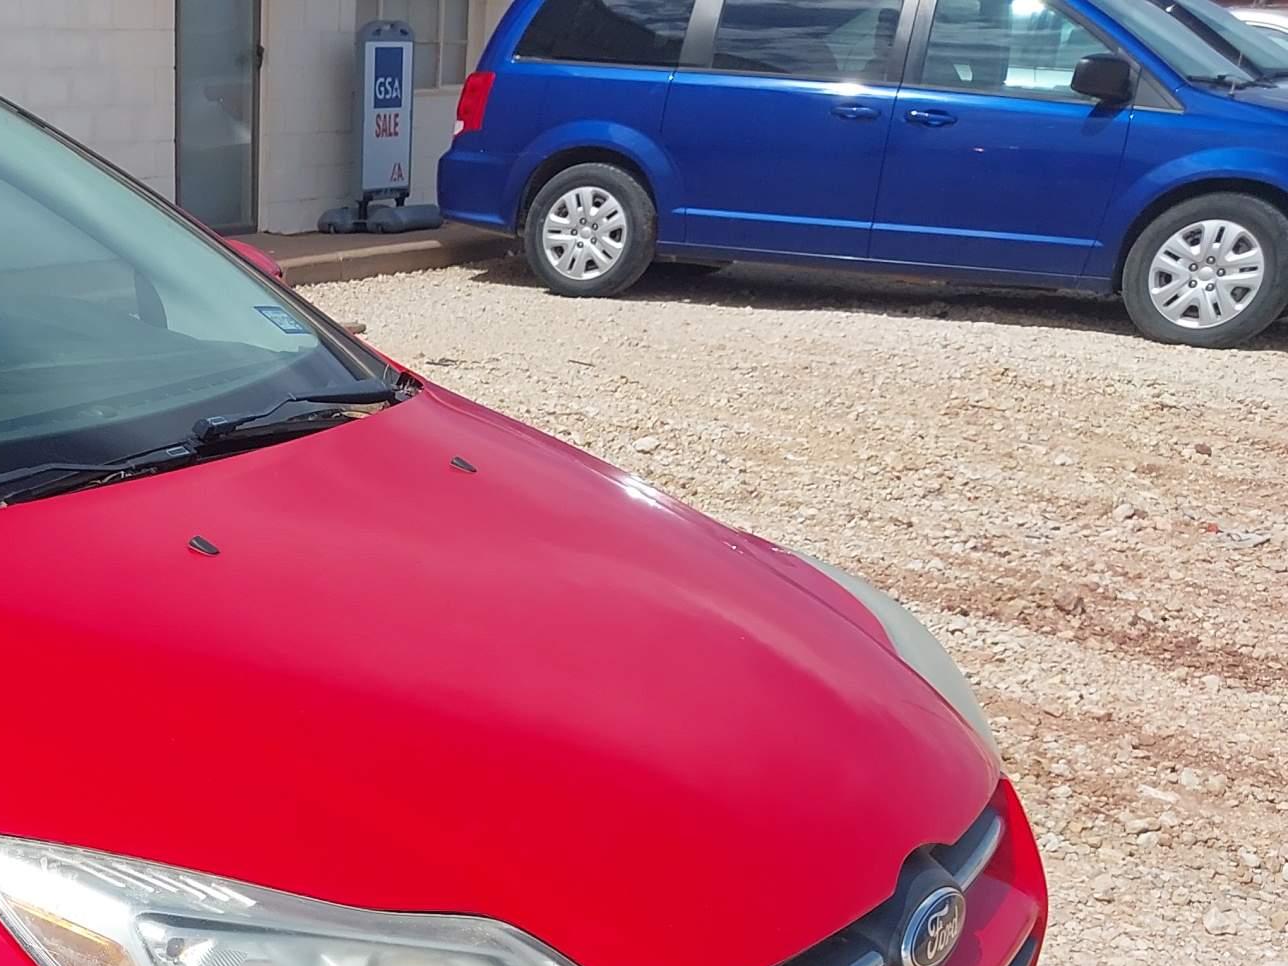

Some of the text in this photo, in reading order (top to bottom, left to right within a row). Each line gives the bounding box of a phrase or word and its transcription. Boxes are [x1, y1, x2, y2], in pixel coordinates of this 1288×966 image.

[375, 77, 401, 99] GSA
[375, 112, 400, 138] SALE
[926, 903, 959, 960] Ford
